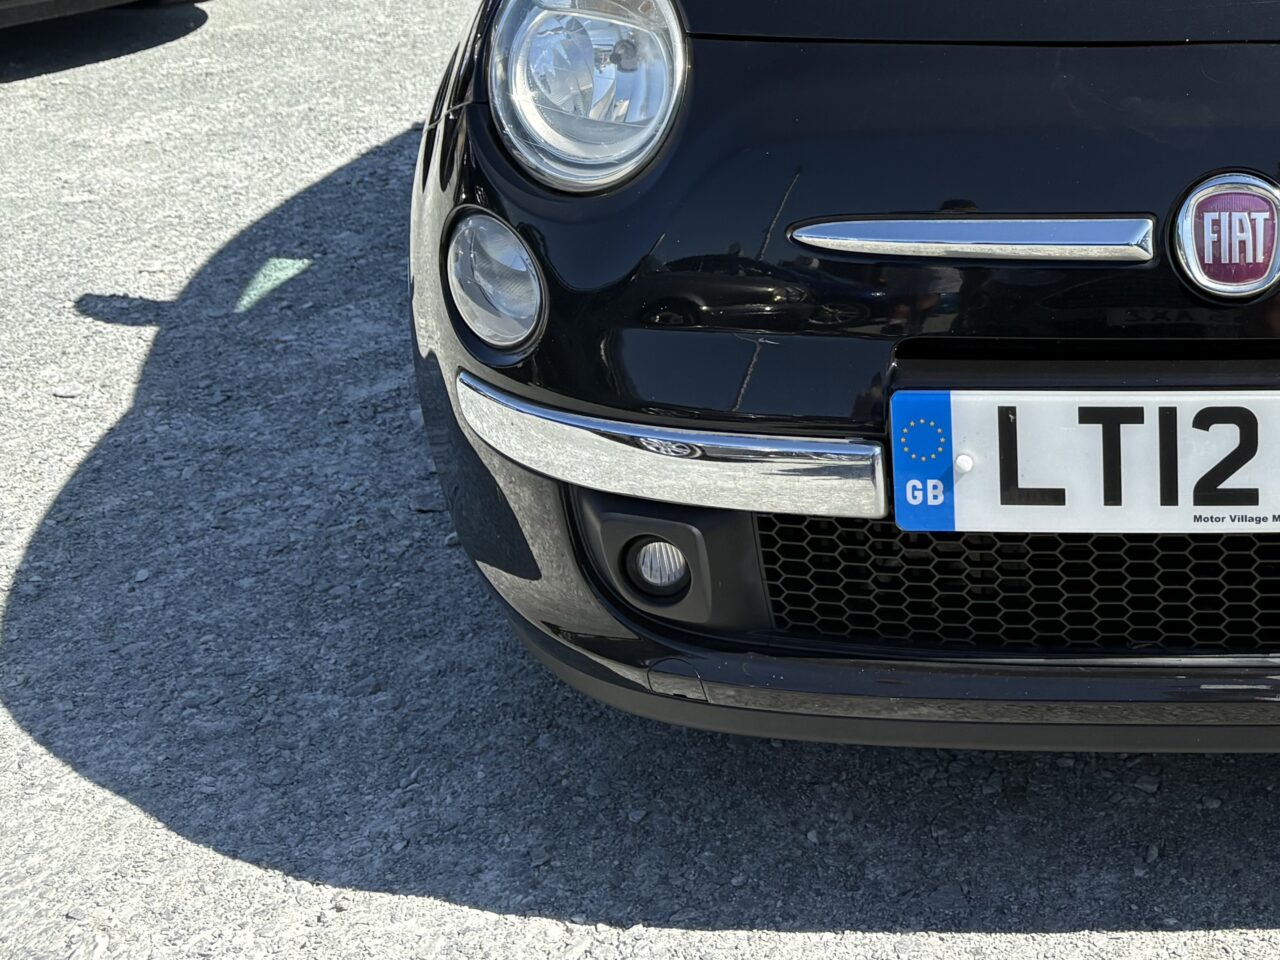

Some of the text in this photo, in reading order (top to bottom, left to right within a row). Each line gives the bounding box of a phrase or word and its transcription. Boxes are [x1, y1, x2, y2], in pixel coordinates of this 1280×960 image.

[1203, 211, 1269, 264] FIAT
[997, 405, 1260, 507] LT12
[905, 478, 945, 506] GB
[1193, 514, 1226, 523] Motor
[1229, 514, 1269, 525] Village
